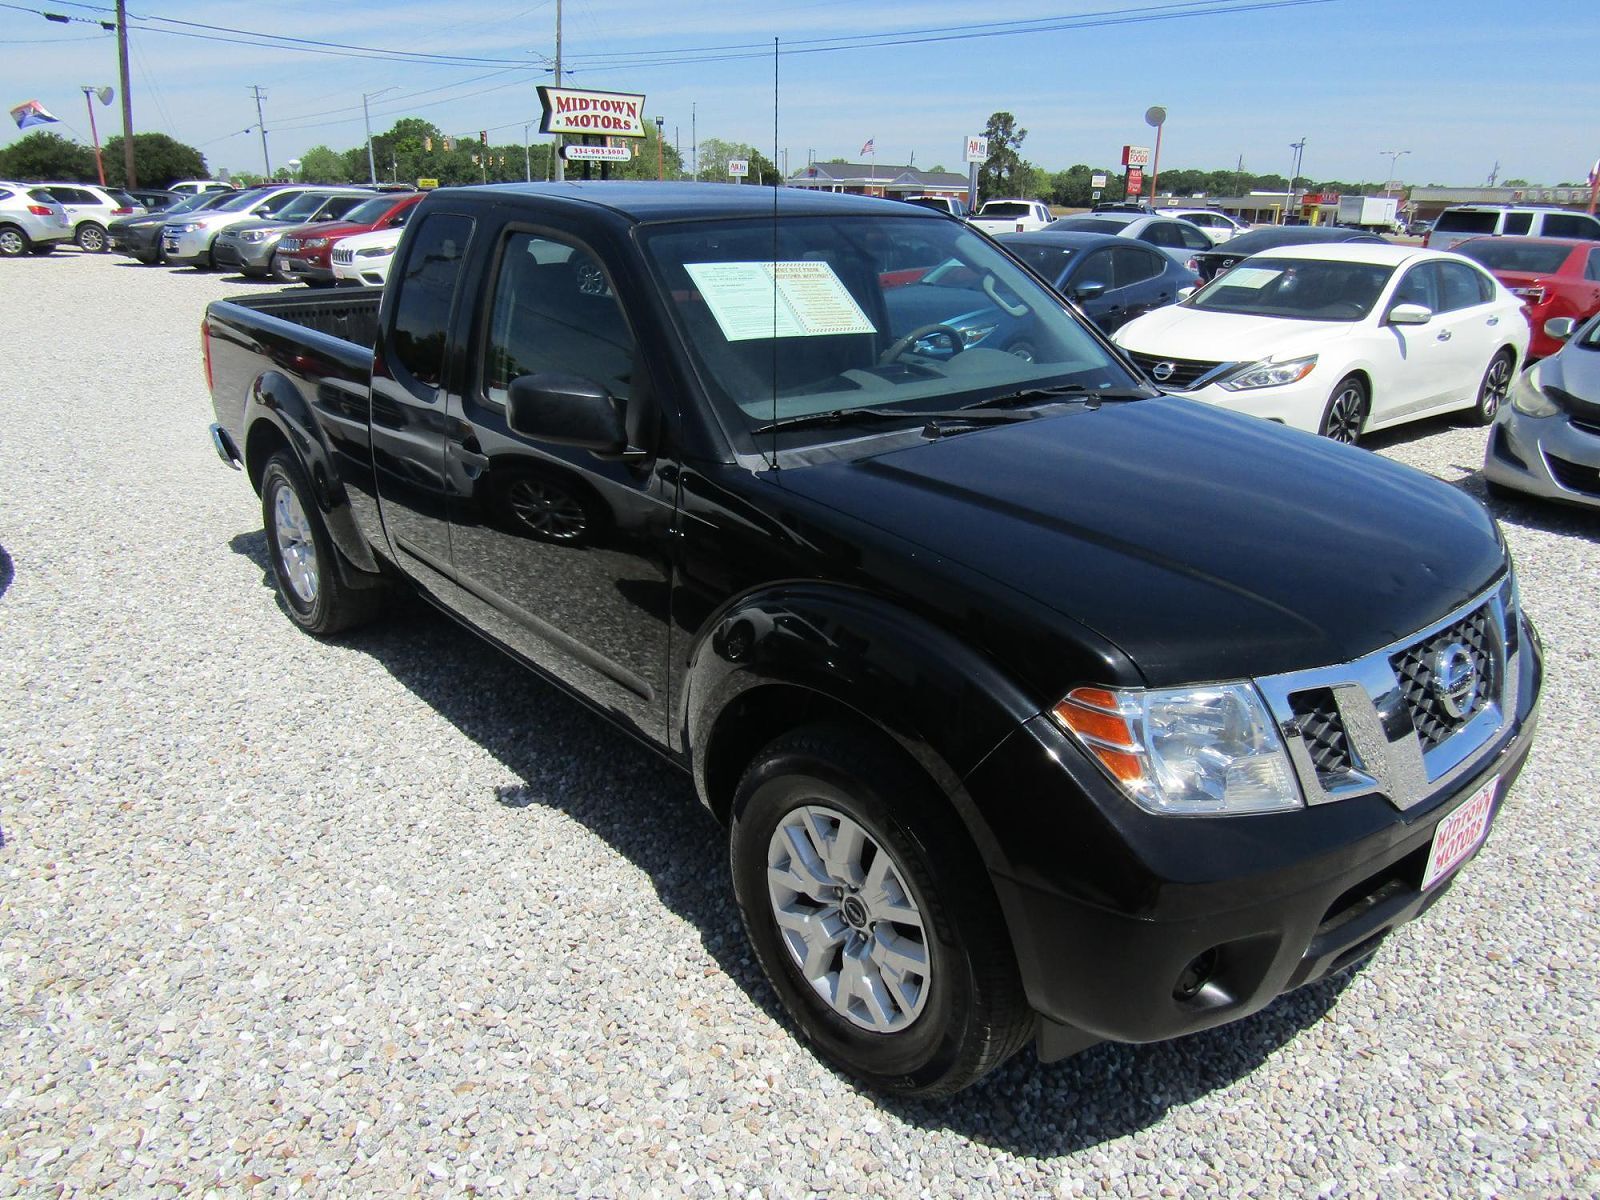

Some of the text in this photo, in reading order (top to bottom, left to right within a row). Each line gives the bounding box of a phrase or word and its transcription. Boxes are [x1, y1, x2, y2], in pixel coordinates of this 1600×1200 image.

[556, 96, 637, 119] MIDTOWN
[565, 114, 631, 131] MOTORS
[1437, 791, 1492, 847] MIDTOWN
[1434, 818, 1483, 869] MOTORS
